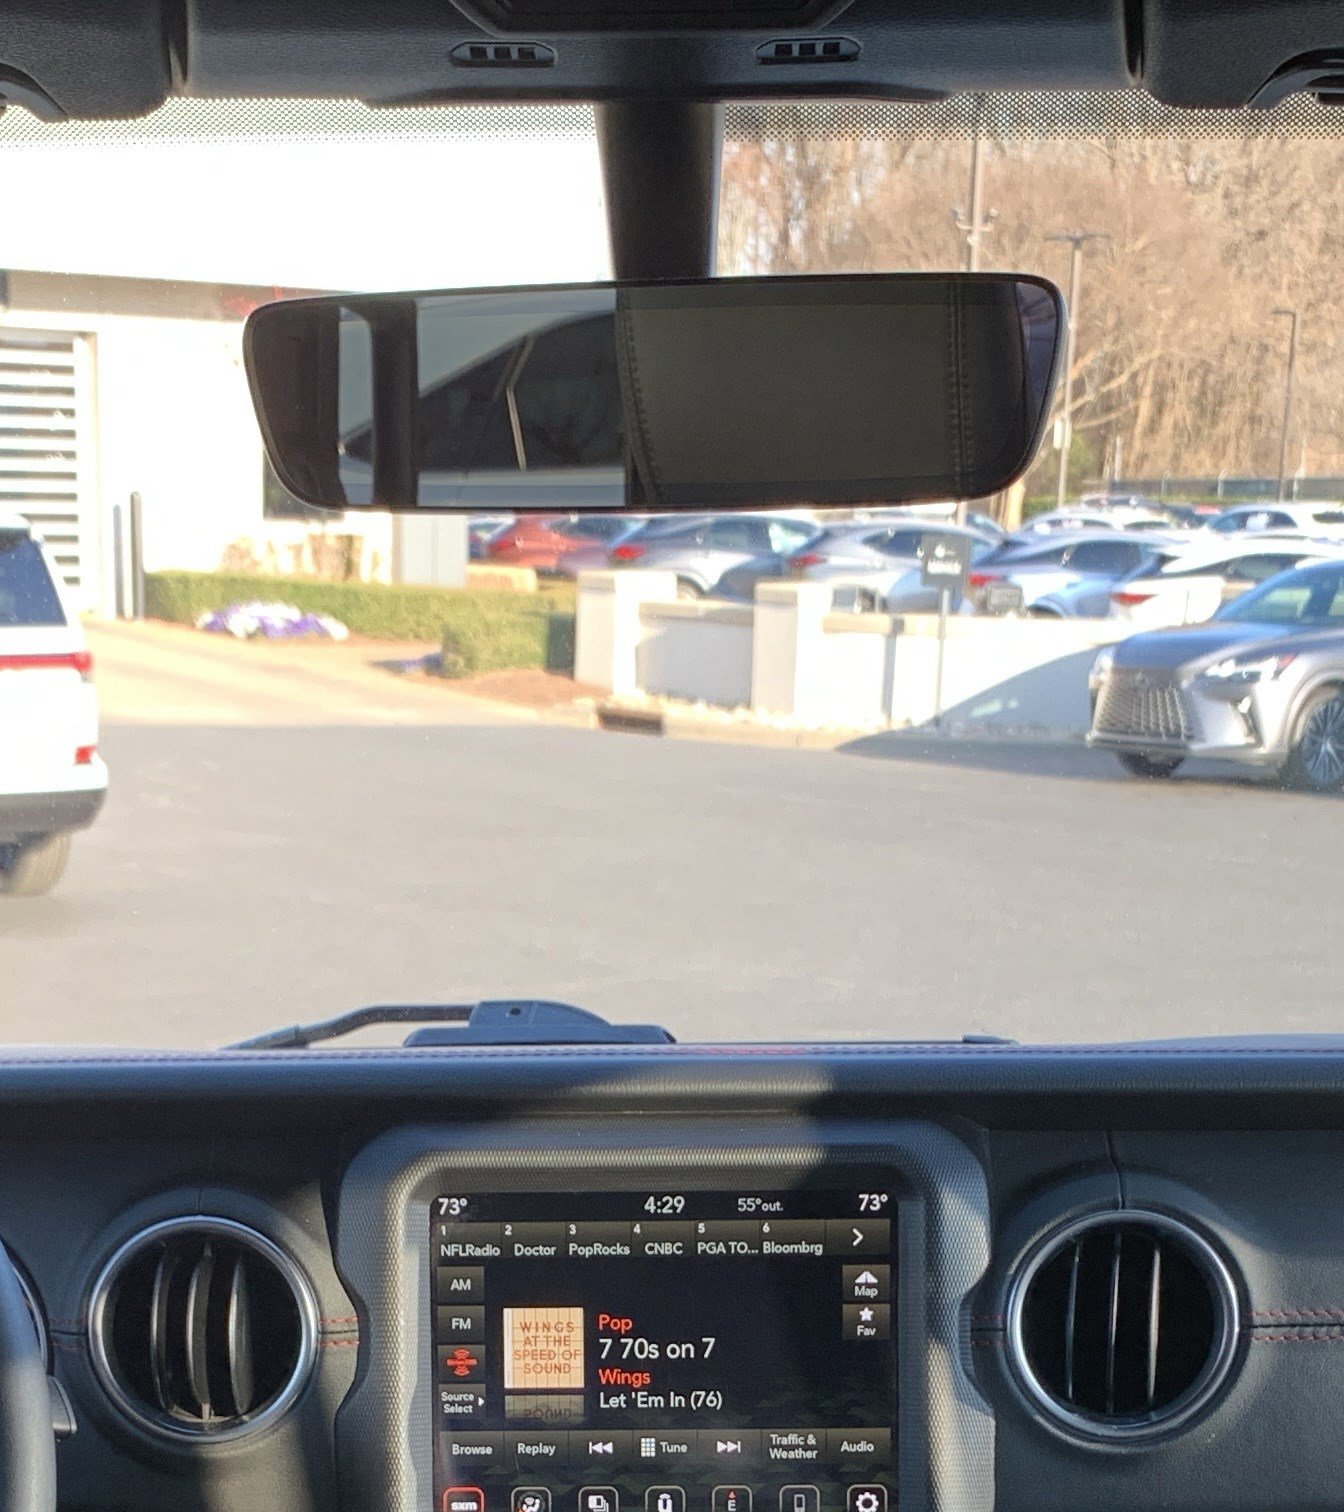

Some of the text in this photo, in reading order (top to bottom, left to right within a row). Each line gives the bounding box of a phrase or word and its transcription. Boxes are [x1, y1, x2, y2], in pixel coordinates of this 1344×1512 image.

[437, 1197, 468, 1216] 73°
[643, 1195, 686, 1214] 4:29
[858, 1193, 889, 1212] 73°
[440, 1225, 447, 1236] 1
[504, 1224, 513, 1236] 2
[568, 1223, 577, 1235] 3
[632, 1223, 641, 1235] 4
[697, 1223, 706, 1234] 5
[762, 1222, 771, 1233] 6
[440, 1243, 501, 1258] NFLRadio
[513, 1243, 557, 1257] Doctor
[568, 1242, 631, 1258] PopRocks
[644, 1242, 684, 1256] CNBC
[697, 1241, 726, 1255] PGA
[762, 1240, 824, 1256] Bloombrg
[449, 1278, 472, 1292] AM
[854, 1285, 879, 1299] Map
[451, 1317, 472, 1330] FM
[518, 1321, 575, 1334] WINGS
[597, 1313, 633, 1333] Pop
[856, 1325, 877, 1337] Fav
[522, 1336, 571, 1347] AT THE
[512, 1349, 581, 1361] SPEED OF
[598, 1337, 716, 1360] 7 70s on 7
[522, 1363, 572, 1375] SOUND
[597, 1368, 652, 1388] Wings
[440, 1392, 475, 1402] Source
[599, 1390, 723, 1410] Let 'Em In (76)
[443, 1403, 473, 1414] Select
[769, 1433, 817, 1446] Traffic &
[840, 1440, 875, 1452] Audio
[451, 1443, 493, 1456] Browse
[517, 1442, 556, 1457] Replay
[659, 1441, 688, 1453] Tune
[769, 1447, 818, 1460] Weather
[450, 1500, 478, 1512] sxm
